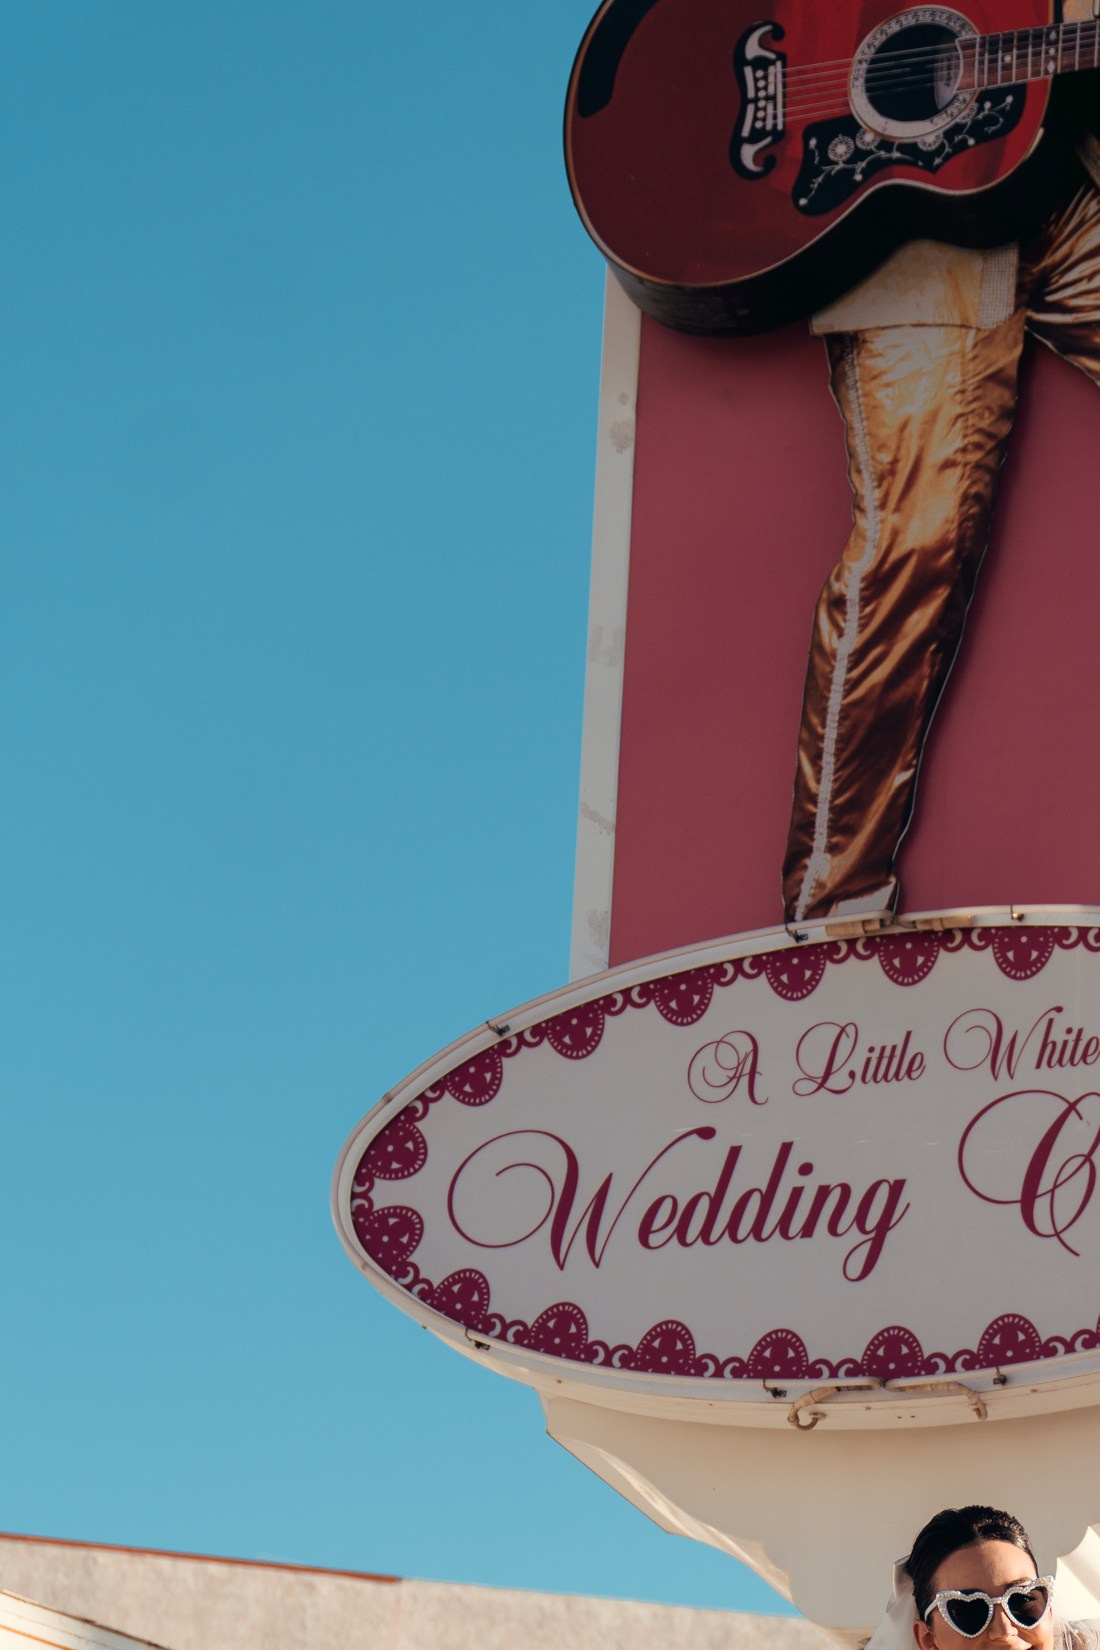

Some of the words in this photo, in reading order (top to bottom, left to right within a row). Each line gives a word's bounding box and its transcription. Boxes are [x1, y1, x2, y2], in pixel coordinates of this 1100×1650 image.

[687, 1029, 768, 1106] A
[794, 1021, 927, 1096] Little
[447, 1126, 910, 1282] Wedding
